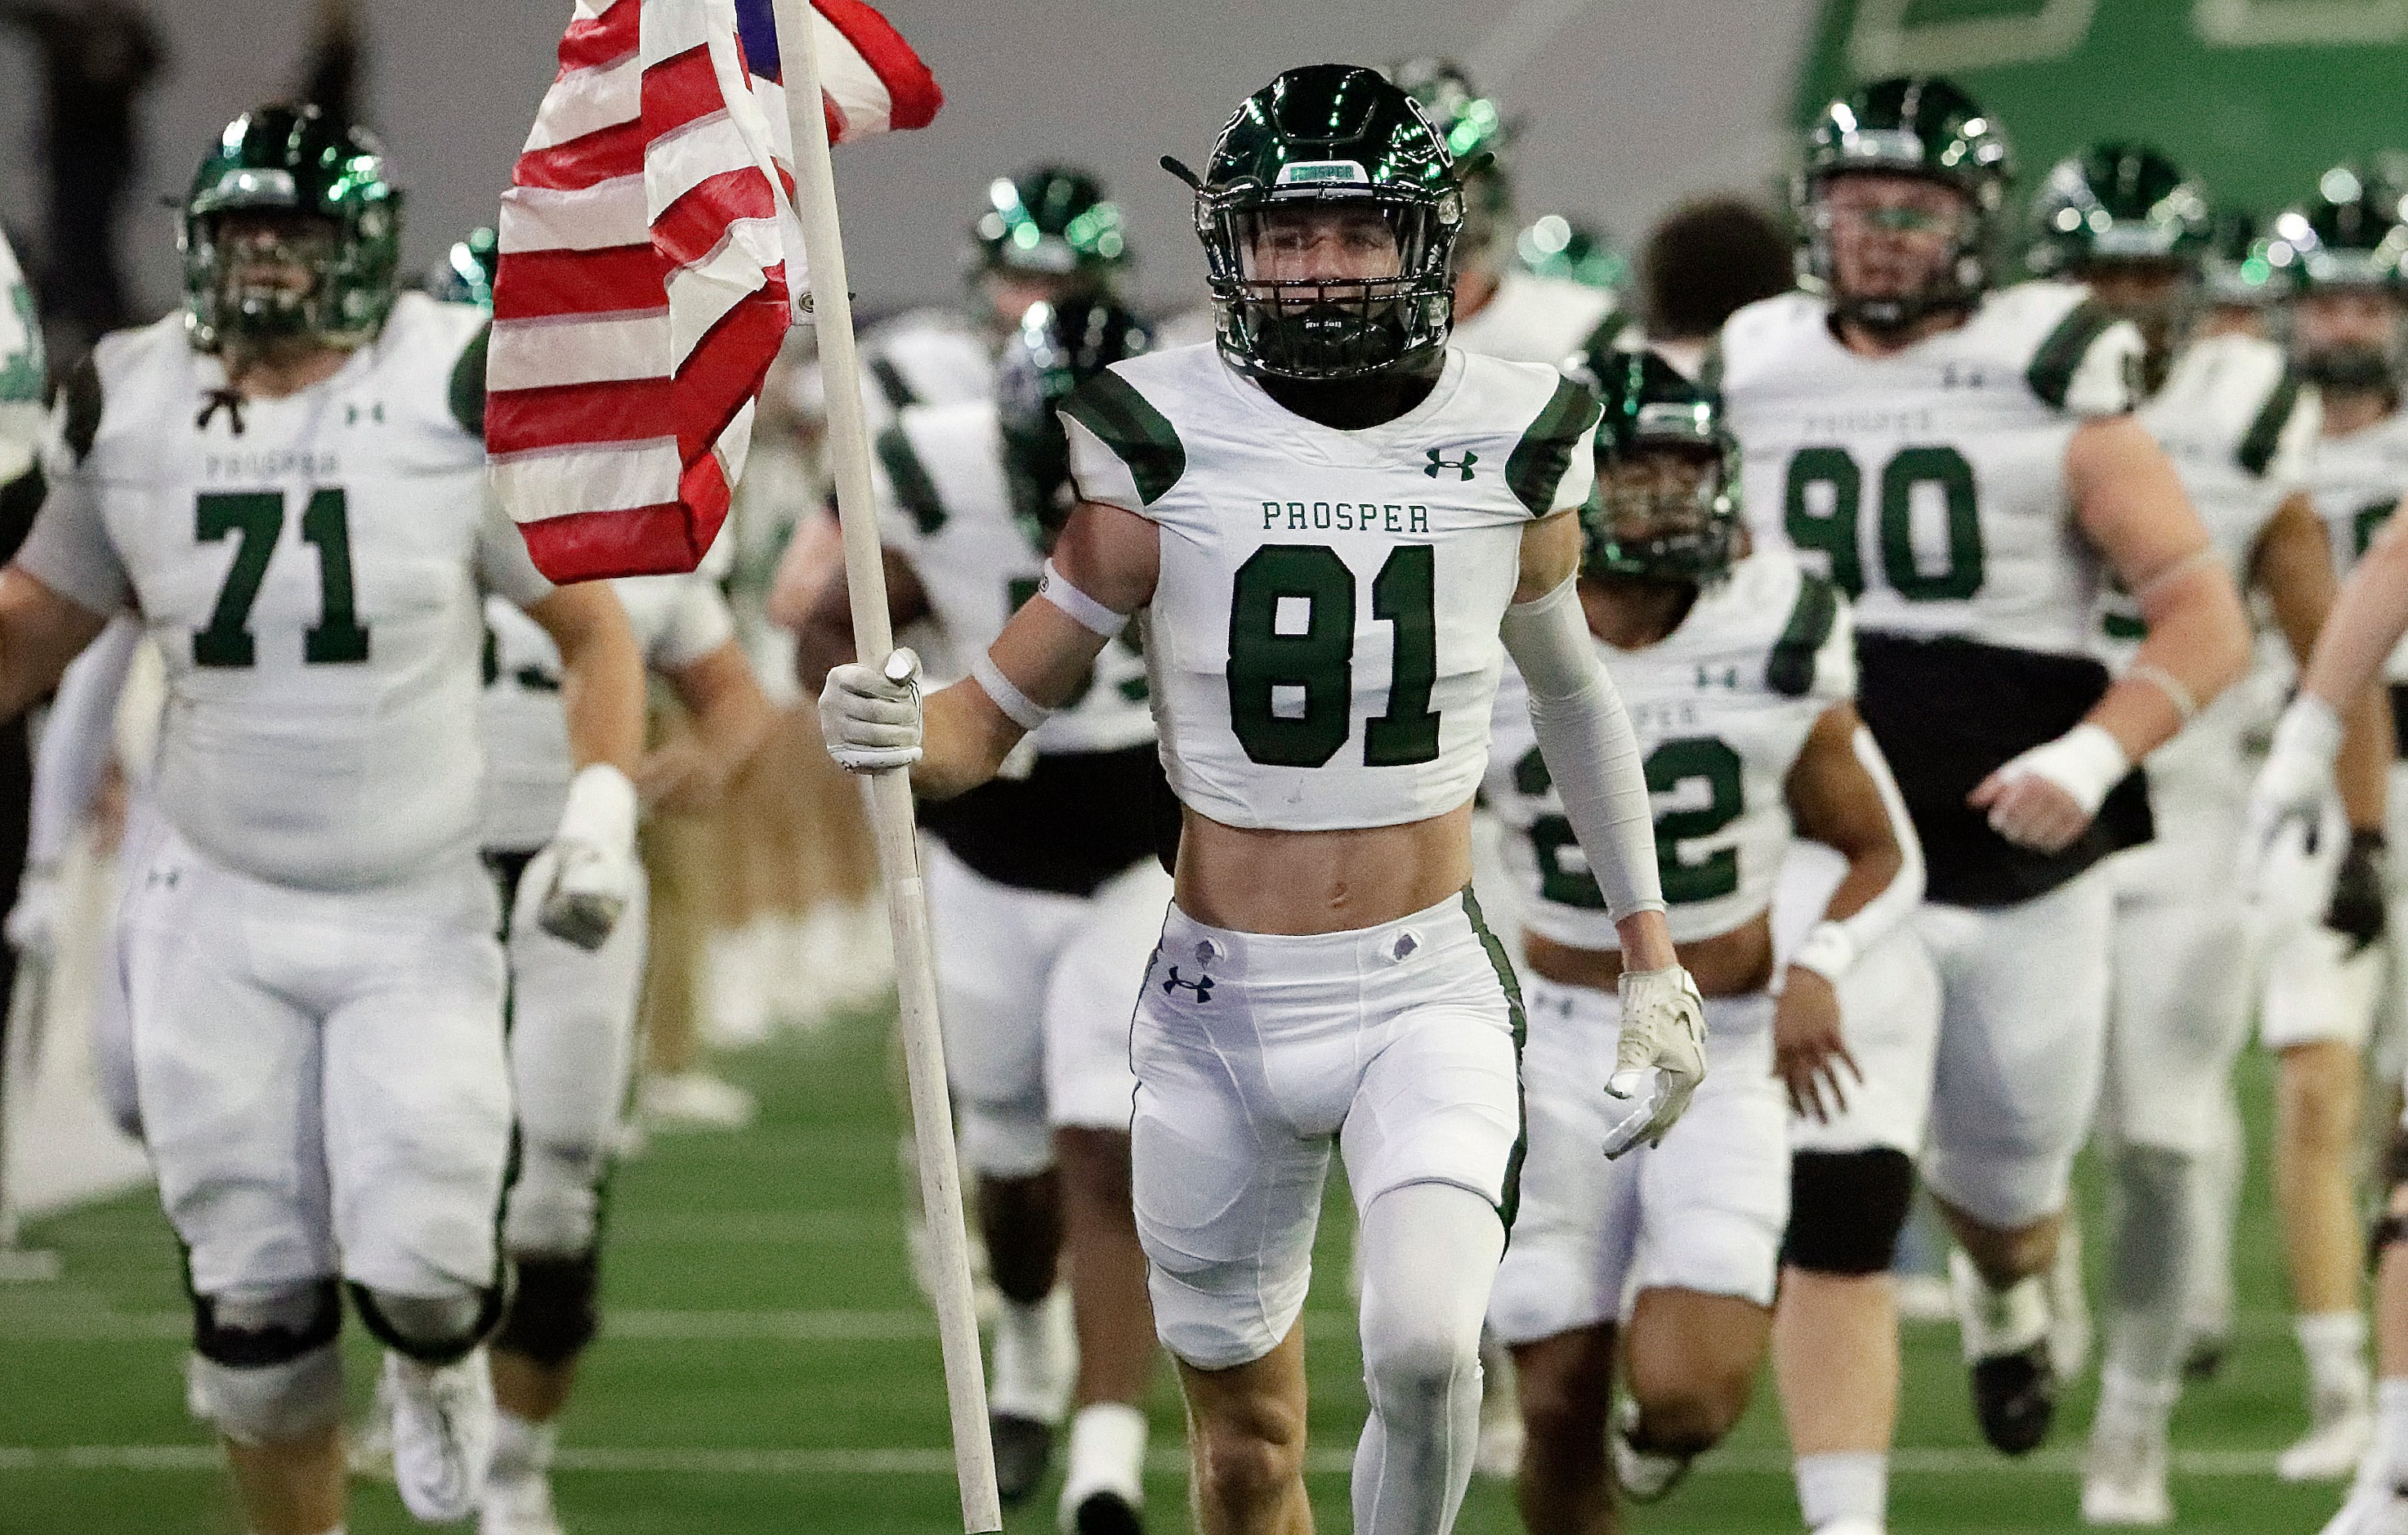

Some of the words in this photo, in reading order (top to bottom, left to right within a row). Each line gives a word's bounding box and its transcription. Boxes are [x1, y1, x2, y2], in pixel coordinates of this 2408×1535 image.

[1290, 165, 1354, 181] PROSPER
[193, 490, 369, 665] 71
[1262, 502, 1429, 532] PROSPER
[1785, 446, 1983, 602] 90
[1226, 544, 1441, 768] 81
